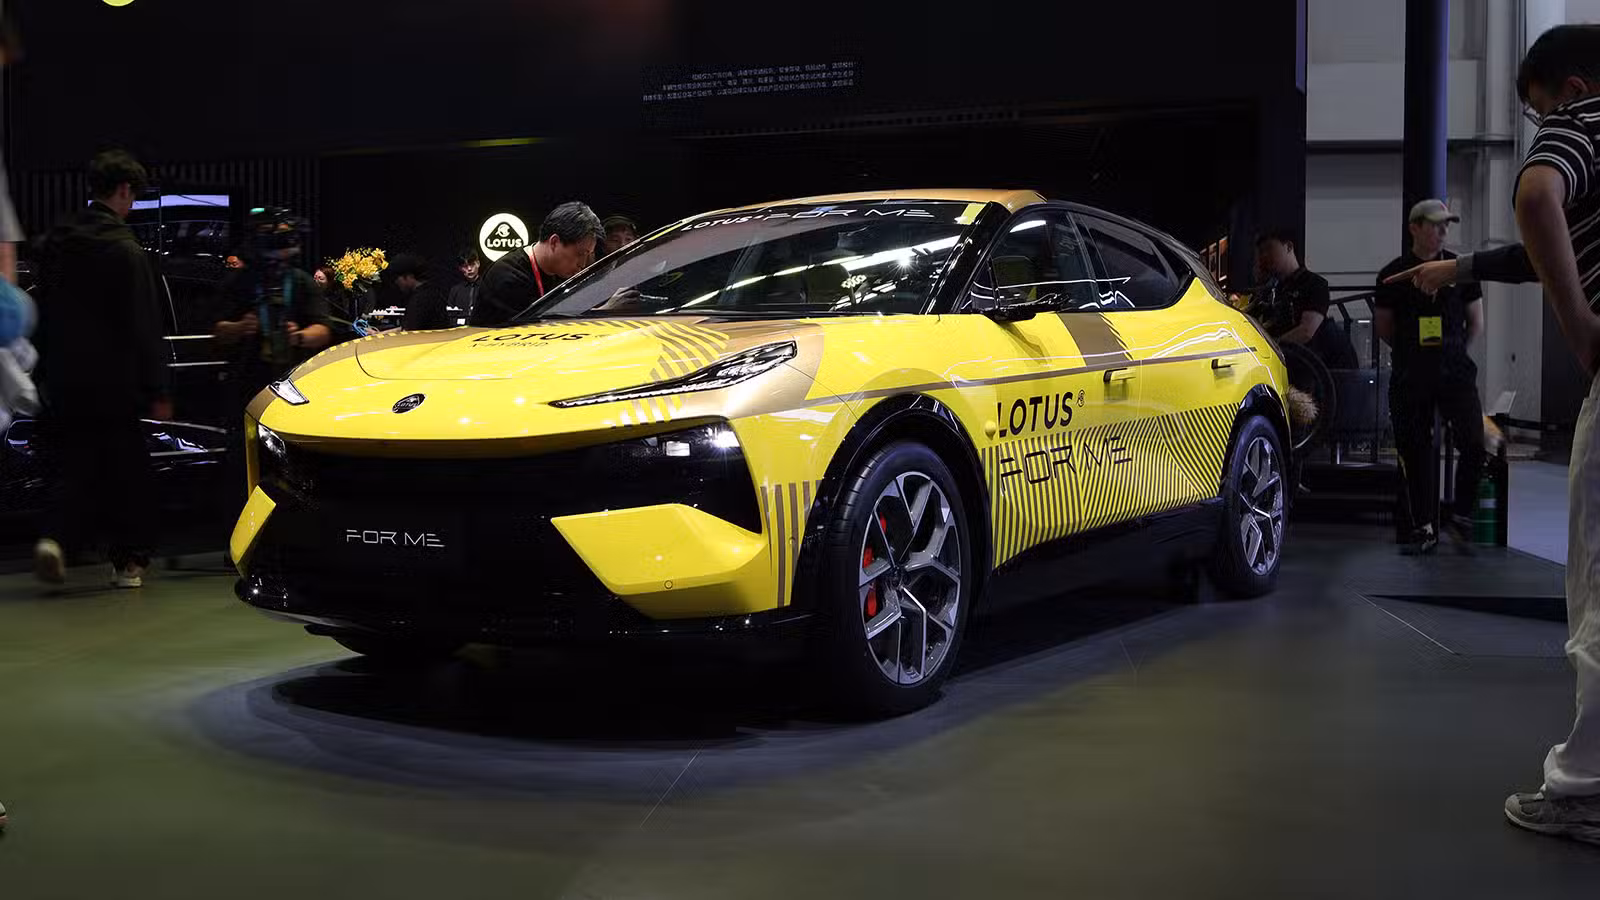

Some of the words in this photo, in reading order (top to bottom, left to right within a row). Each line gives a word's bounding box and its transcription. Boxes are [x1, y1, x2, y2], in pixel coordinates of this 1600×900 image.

[680, 216, 749, 231] LOTUS
[763, 209, 857, 221] FOR
[864, 208, 934, 218] ME
[486, 238, 522, 248] LOTUS
[472, 333, 590, 342] LOTUS
[997, 391, 1073, 438] LOTUS
[1000, 445, 1076, 493] FOR
[1083, 437, 1132, 471] ME
[346, 529, 397, 544] FOR
[404, 532, 445, 547] ME
